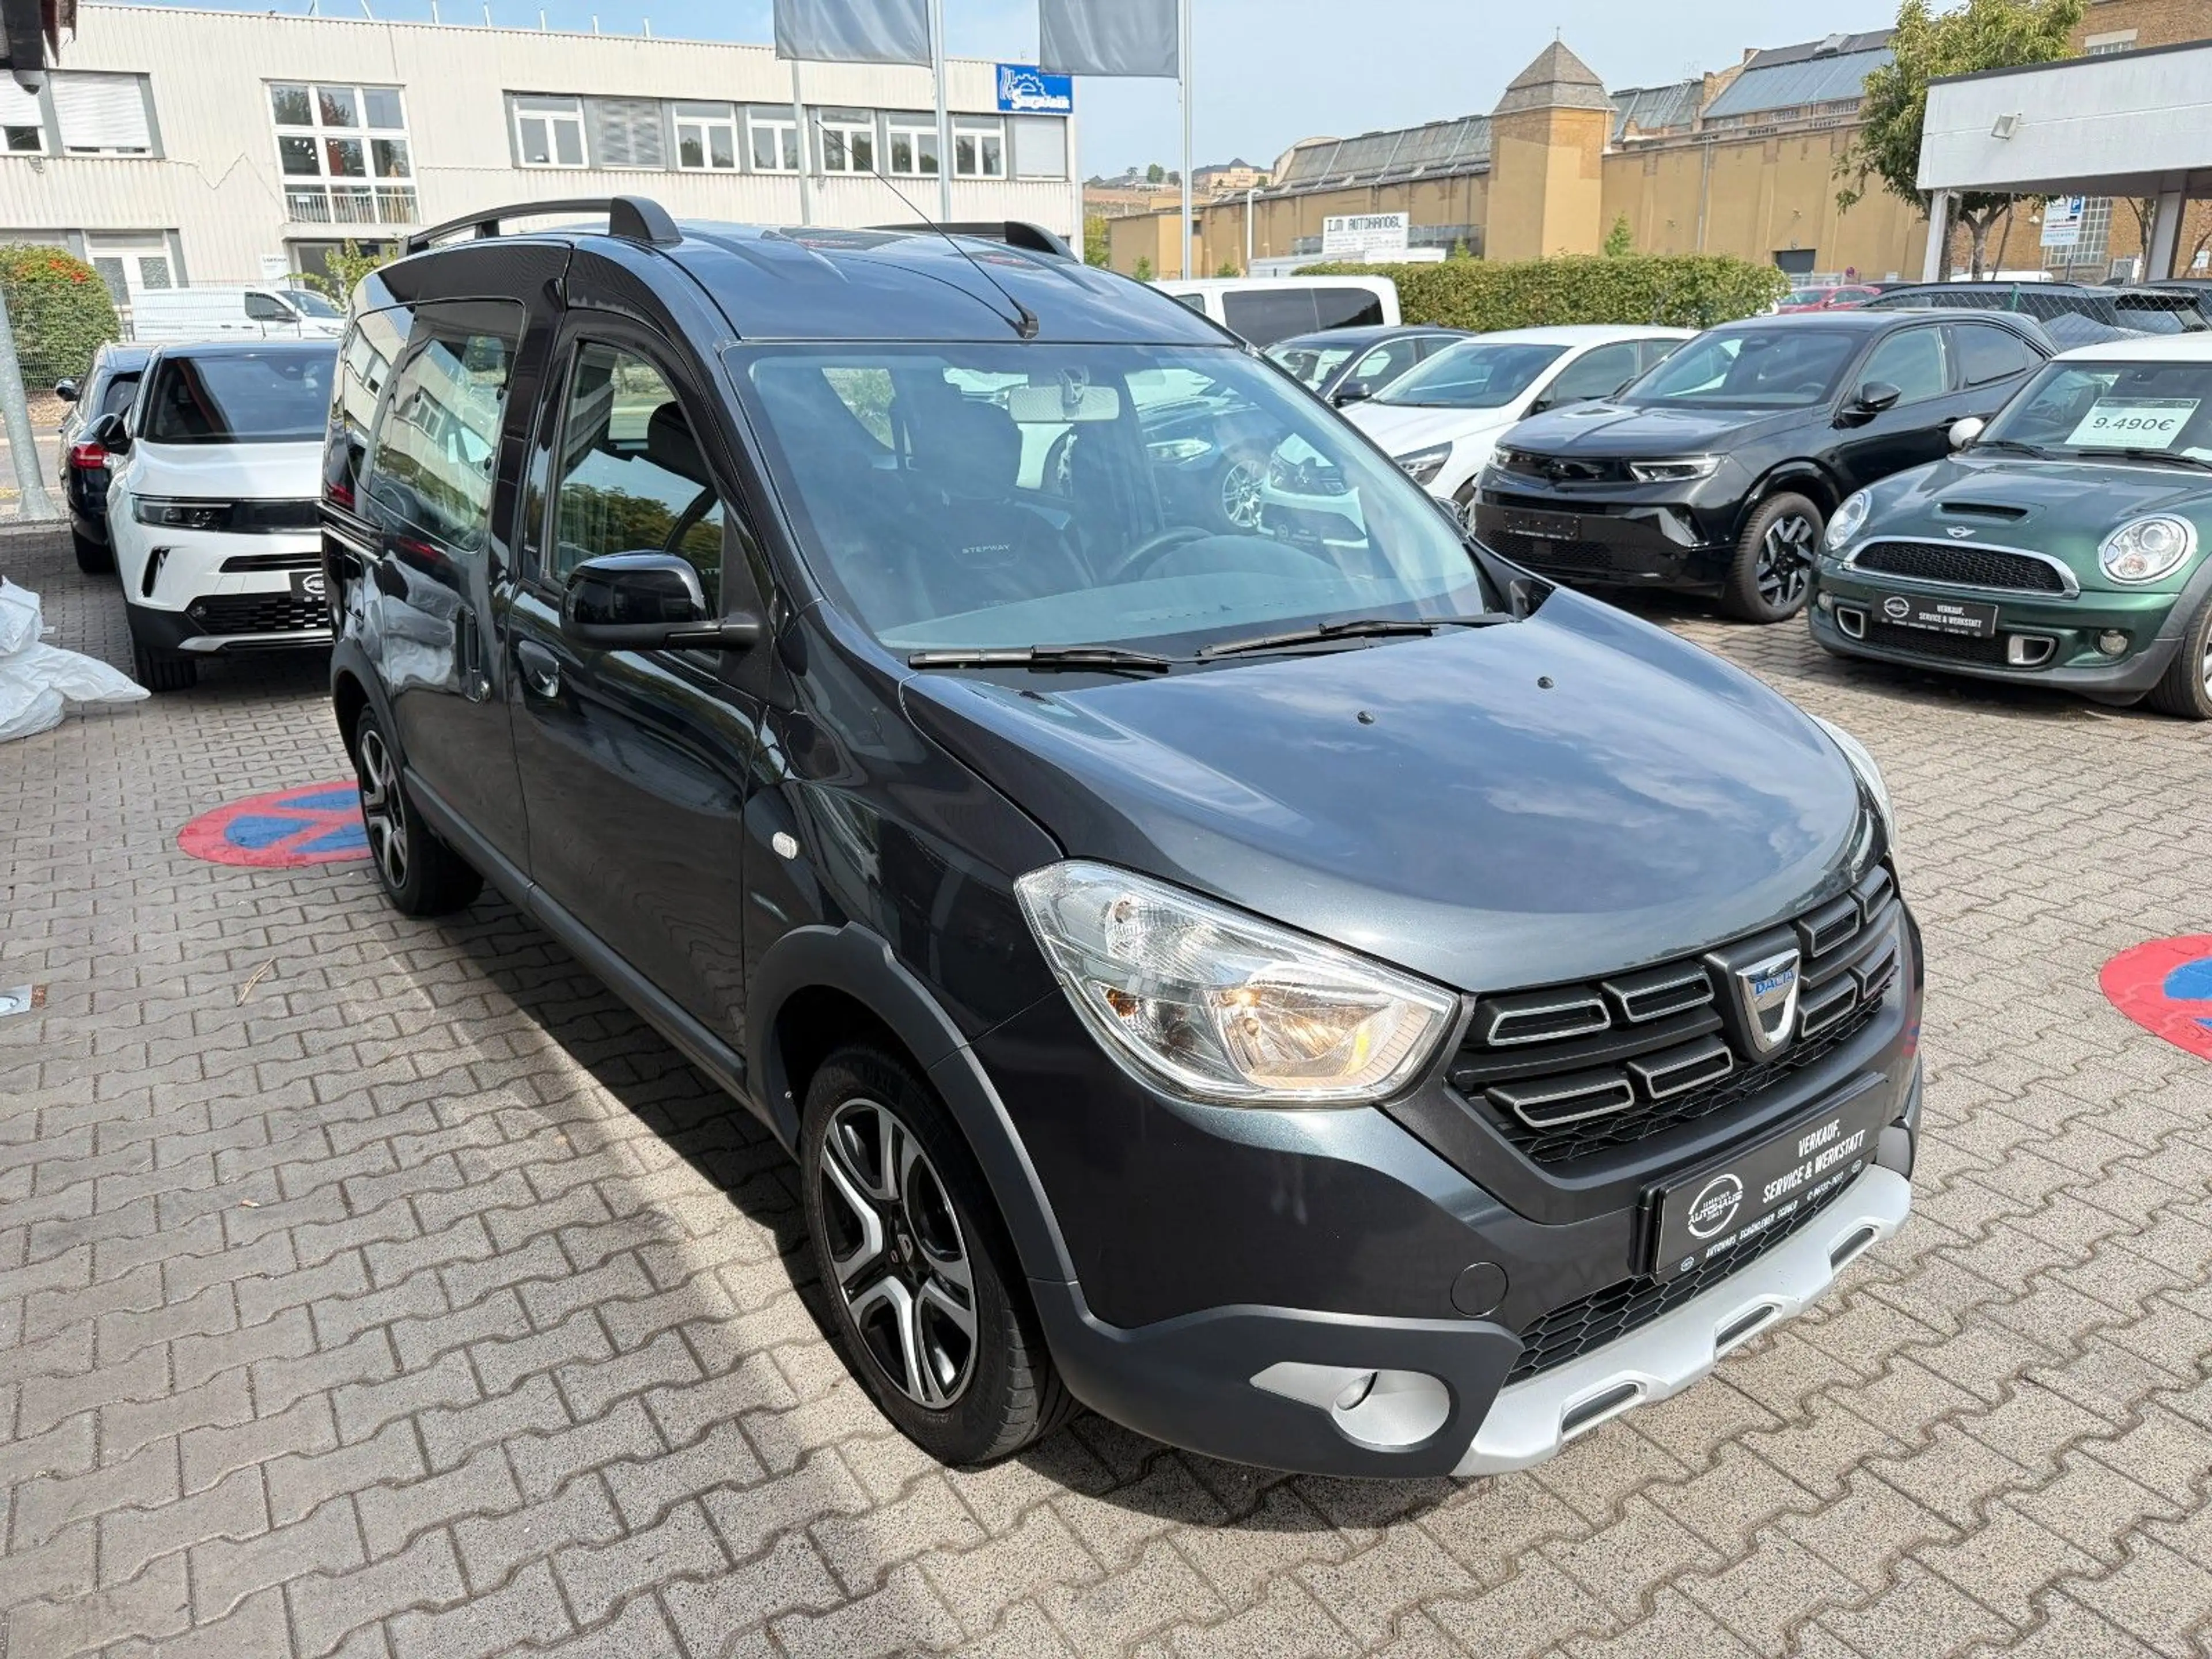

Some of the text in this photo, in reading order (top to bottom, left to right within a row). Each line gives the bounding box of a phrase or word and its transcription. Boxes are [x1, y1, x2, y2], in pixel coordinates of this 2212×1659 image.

[2093, 417, 2175, 431] 9.490€
[962, 544, 1010, 554] STEPWAY
[1919, 612, 1942, 622] SERVICE
[1755, 970, 1794, 995] DACIA
[1798, 1118, 1840, 1158] VERKAUF,
[1763, 1165, 1805, 1203] SERVICE
[1804, 1161, 1812, 1180] &
[1815, 1128, 1866, 1174] WERKSTATT
[1688, 1190, 1743, 1226] AUTOHAUS
